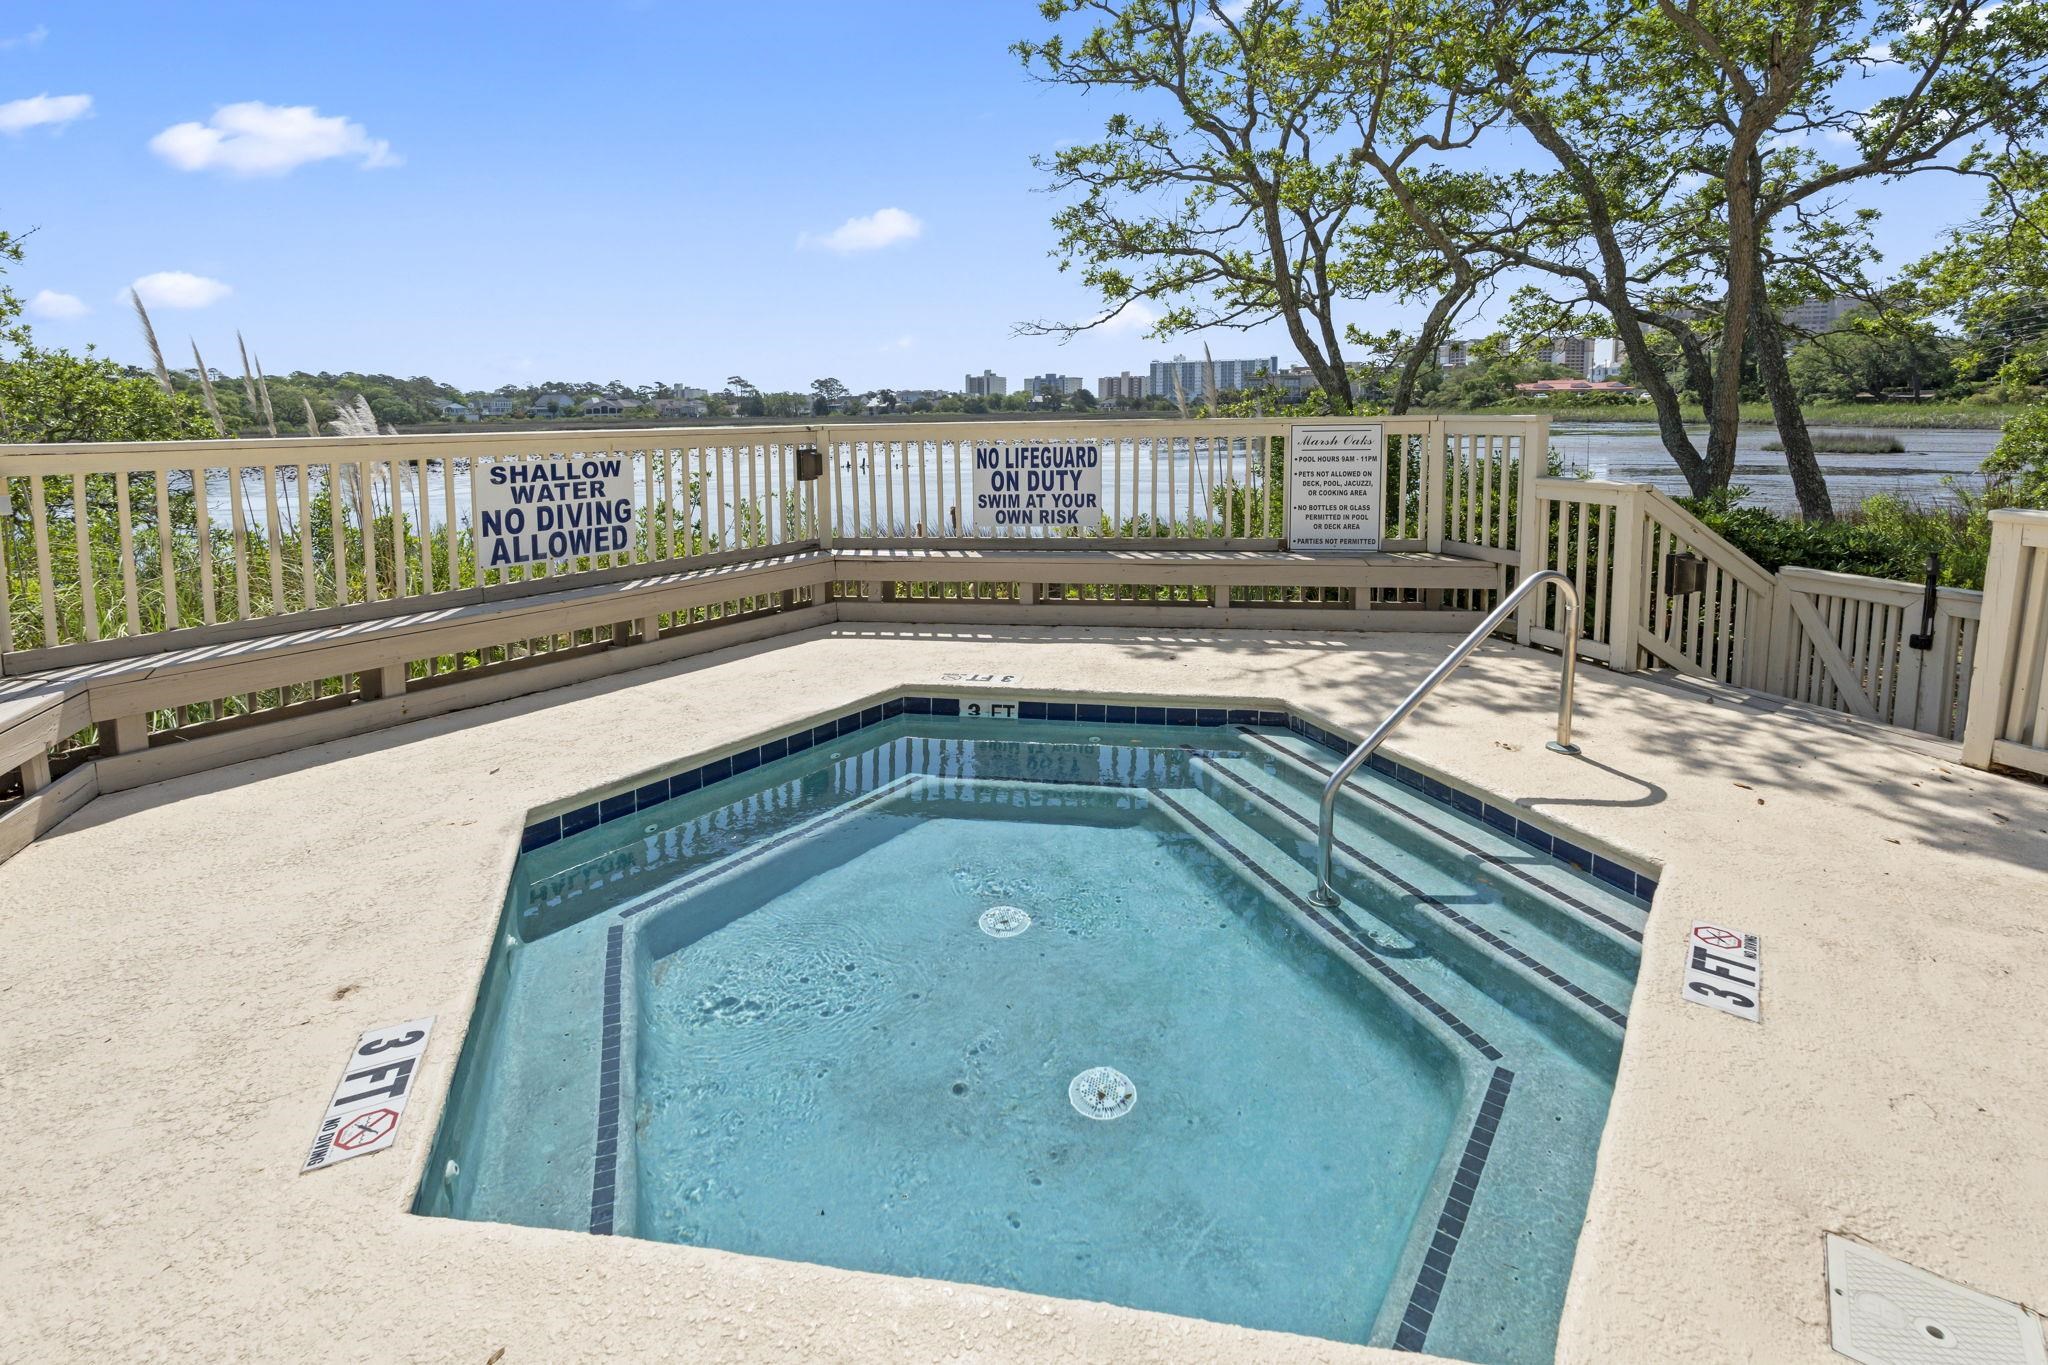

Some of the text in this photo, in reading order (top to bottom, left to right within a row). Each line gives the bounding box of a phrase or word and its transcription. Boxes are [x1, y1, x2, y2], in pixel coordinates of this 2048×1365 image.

[1298, 435, 1374, 445] Marsh Oaks
[977, 446, 1097, 469] NO LIFEGUARD
[490, 460, 621, 485] SHALLOW
[991, 470, 1082, 491] ON DUTY
[511, 481, 606, 504] WATER
[978, 494, 1096, 508] SWIM AT YOUR
[481, 499, 631, 537] NO DIVING
[995, 510, 1078, 524] OWN RISK
[490, 525, 628, 566] ALLOWED
[968, 704, 1015, 717] 3 FT
[1689, 946, 1755, 1008] 3 FT
[334, 1030, 425, 1107] 3 FT
[307, 1117, 341, 1167] NO DIVING
